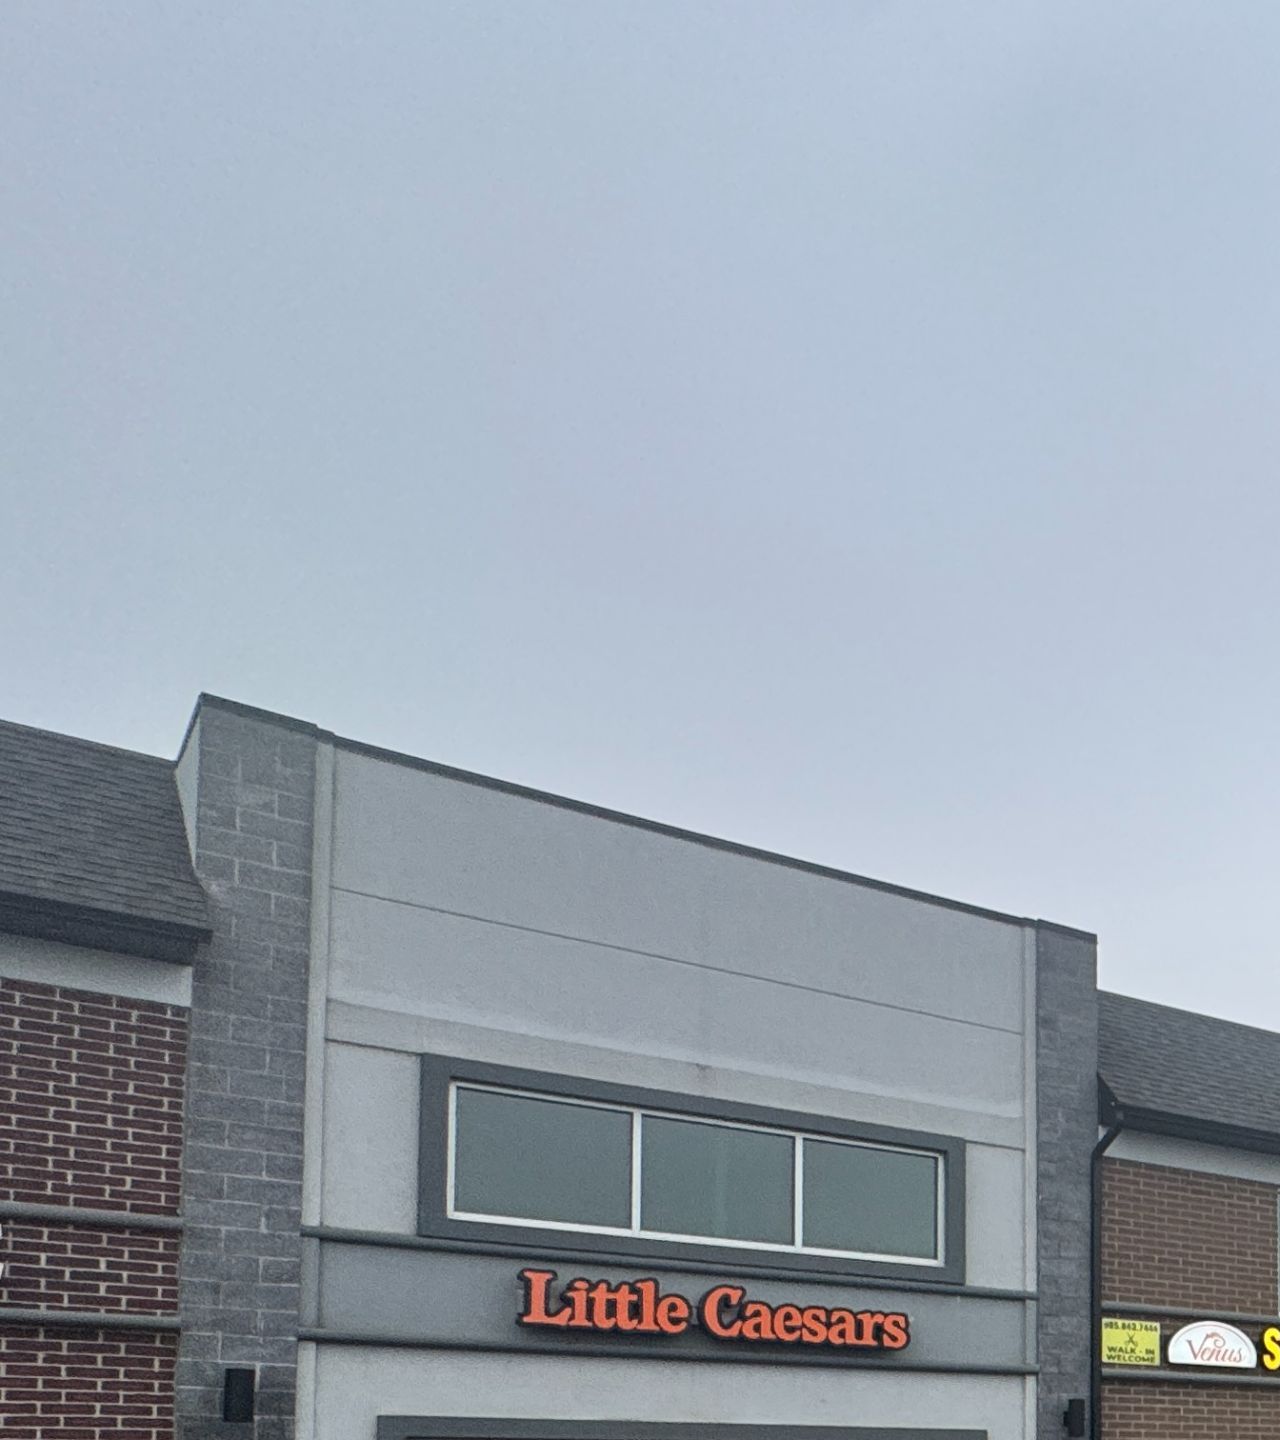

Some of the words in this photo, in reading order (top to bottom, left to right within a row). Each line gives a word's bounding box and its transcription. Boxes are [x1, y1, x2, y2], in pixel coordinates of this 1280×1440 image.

[521, 1268, 689, 1335] Little
[702, 1284, 910, 1349] Caesars
[1107, 1346, 1136, 1354] WALK
[1186, 1332, 1243, 1363] Venus
[1106, 1354, 1155, 1363] WELCOME
